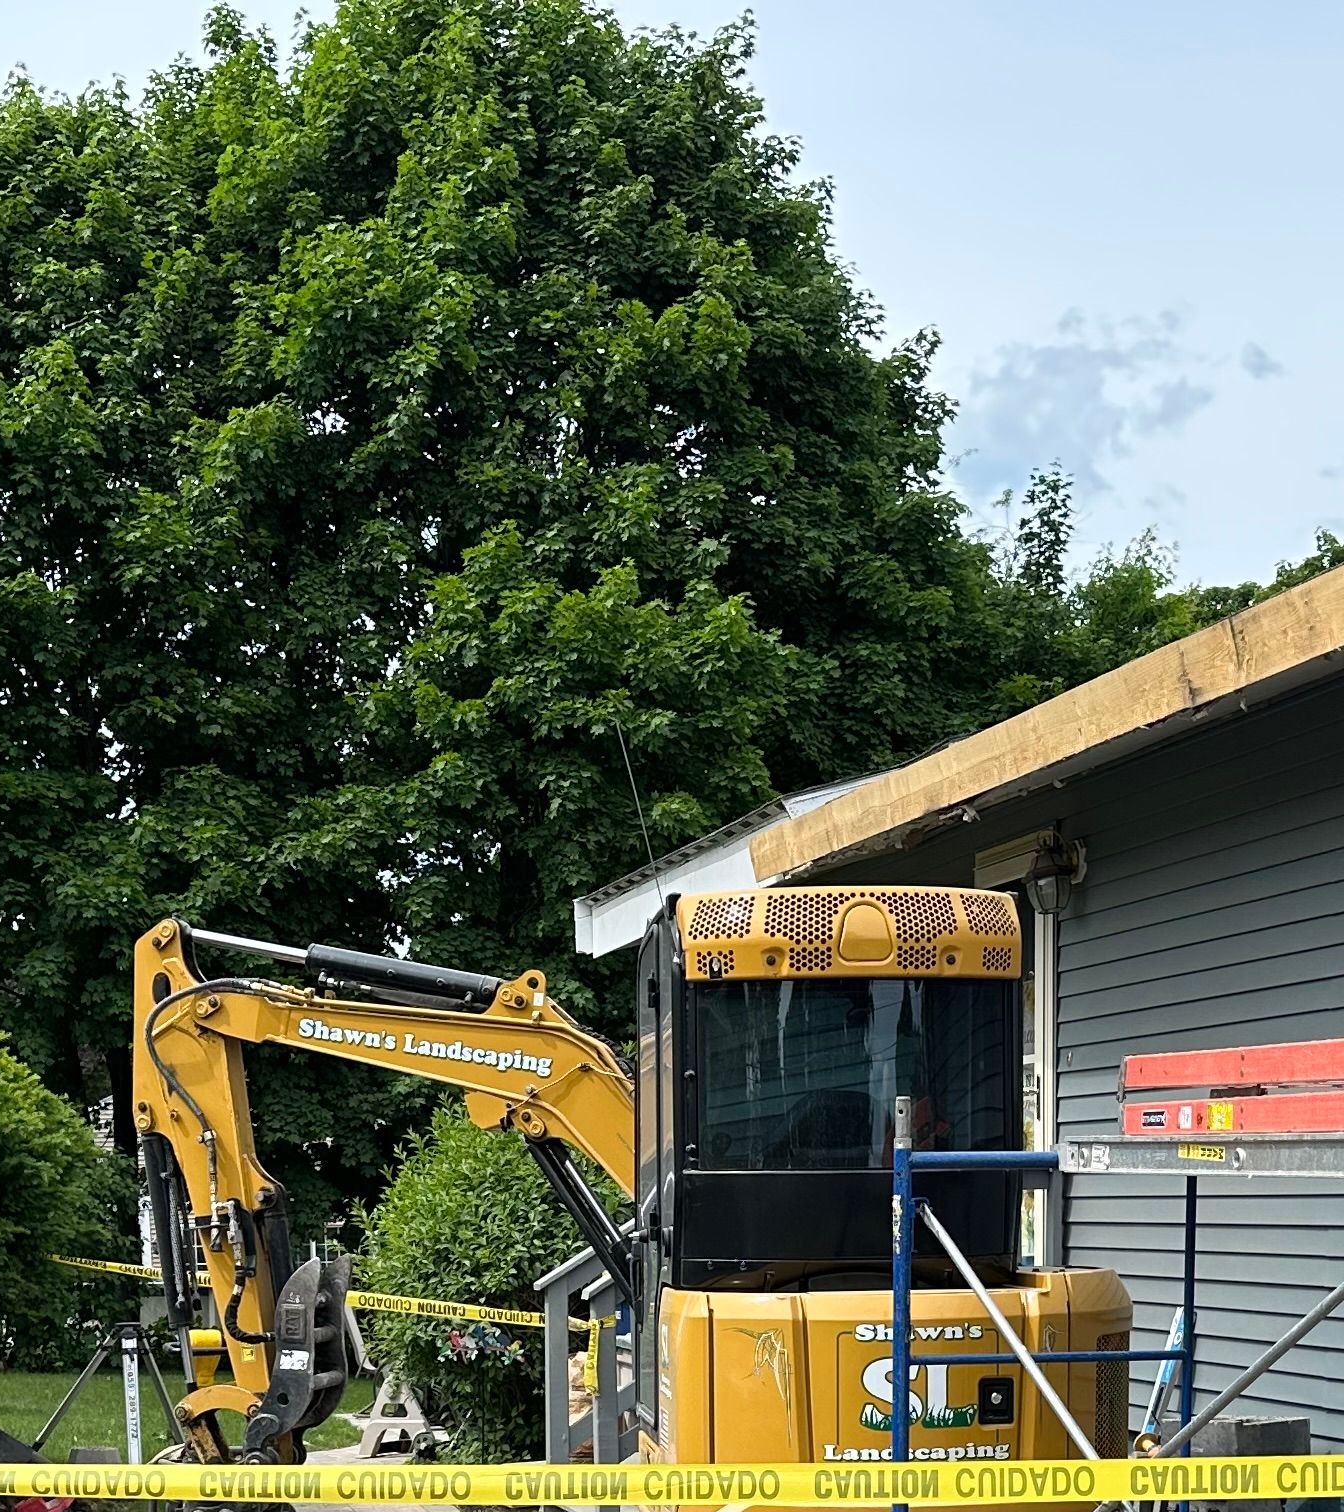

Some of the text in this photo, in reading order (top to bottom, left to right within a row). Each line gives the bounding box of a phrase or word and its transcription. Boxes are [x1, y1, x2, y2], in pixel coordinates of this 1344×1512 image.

[298, 1018, 554, 1077] Shawn's Landscaping
[358, 1294, 412, 1312] CUIDADO
[417, 1301, 466, 1317] CAUTION
[478, 1307, 533, 1324] CUIDADO
[854, 1322, 984, 1342] Shwn's
